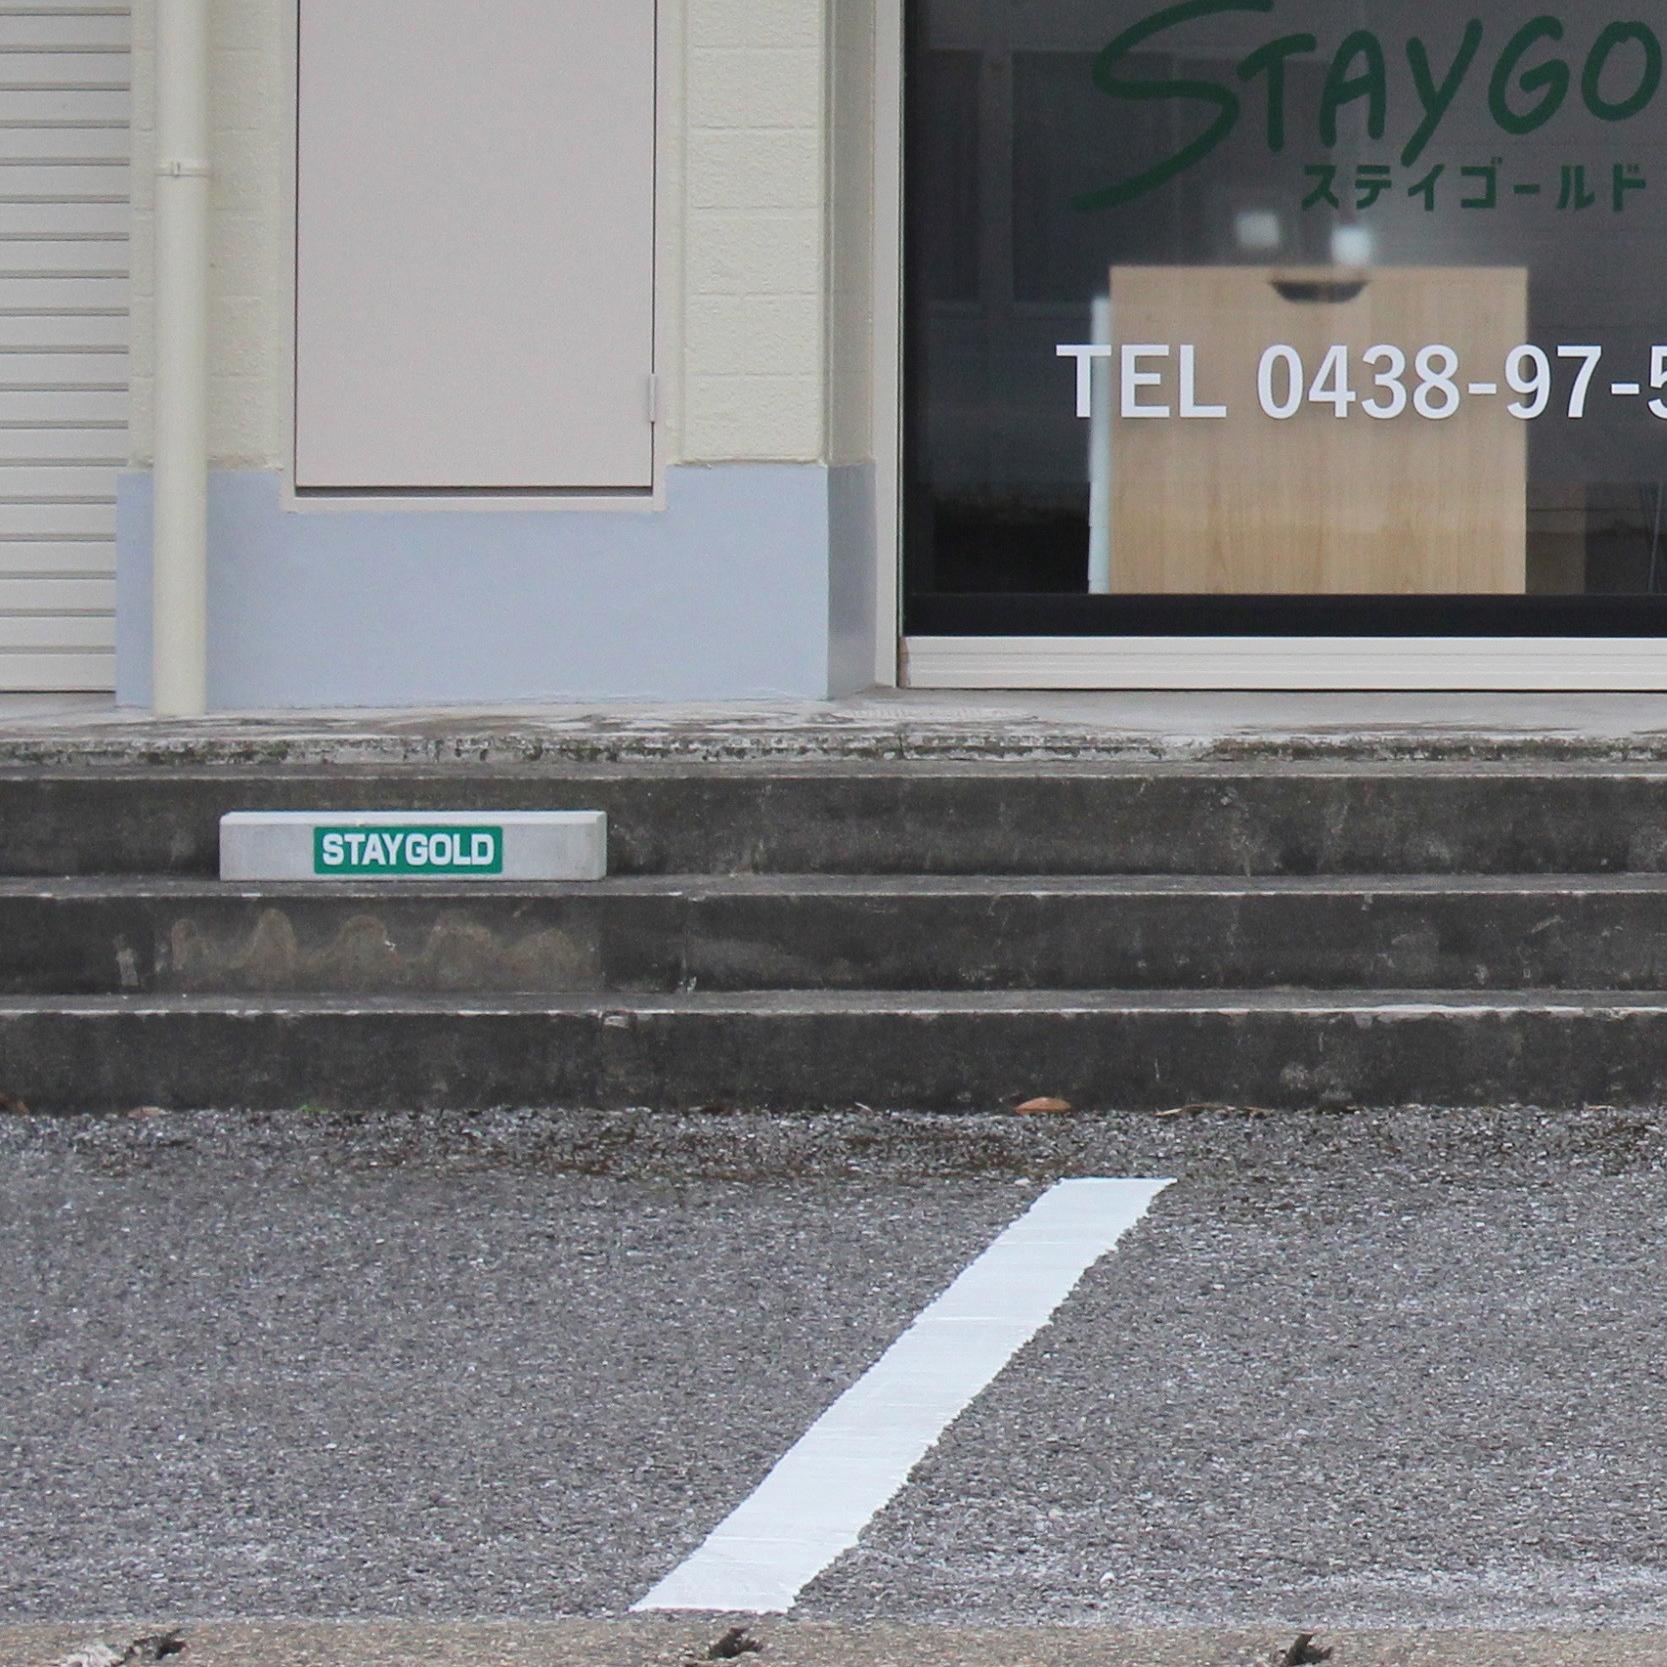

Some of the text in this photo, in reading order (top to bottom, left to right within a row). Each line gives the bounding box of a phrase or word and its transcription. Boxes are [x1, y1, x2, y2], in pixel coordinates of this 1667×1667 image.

[1300, 156, 1648, 212] ステイゴールド
[1056, 344, 1227, 419] TEL
[322, 833, 495, 866] STAYGOLD
